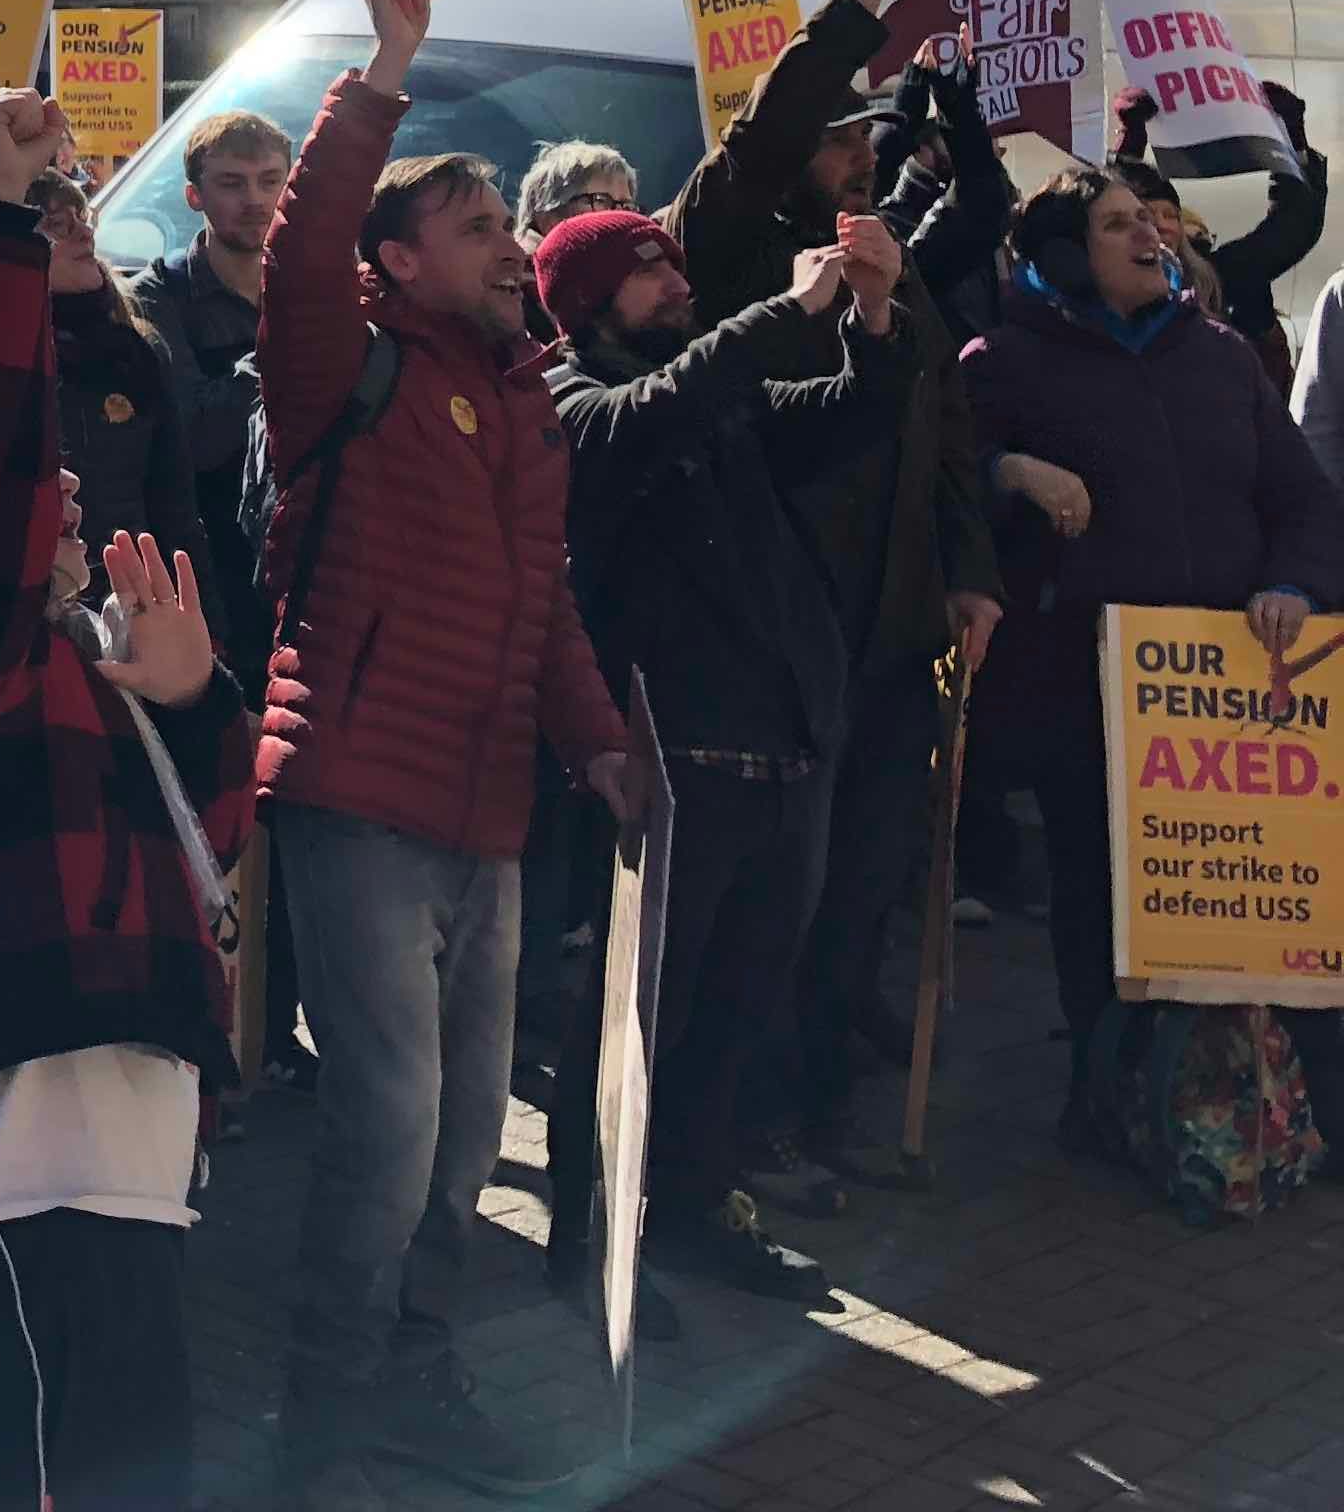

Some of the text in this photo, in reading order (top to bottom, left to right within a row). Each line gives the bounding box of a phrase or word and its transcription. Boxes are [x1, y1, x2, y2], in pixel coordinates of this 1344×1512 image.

[62, 23, 100, 37] OUR
[62, 39, 144, 56] PENSION
[62, 60, 147, 84] AXED.
[62, 91, 112, 103] Support
[1154, 64, 1264, 115] PICK
[70, 119, 134, 132] efend USS
[86, 106, 122, 117] strike
[124, 106, 138, 117] to
[1135, 640, 1226, 677] OUR
[1136, 682, 1329, 730] PENSION
[1138, 736, 1342, 800] AXED.
[1141, 814, 1264, 848] Support
[1142, 854, 1320, 886] our strike to
[1143, 888, 1312, 923] defend USS
